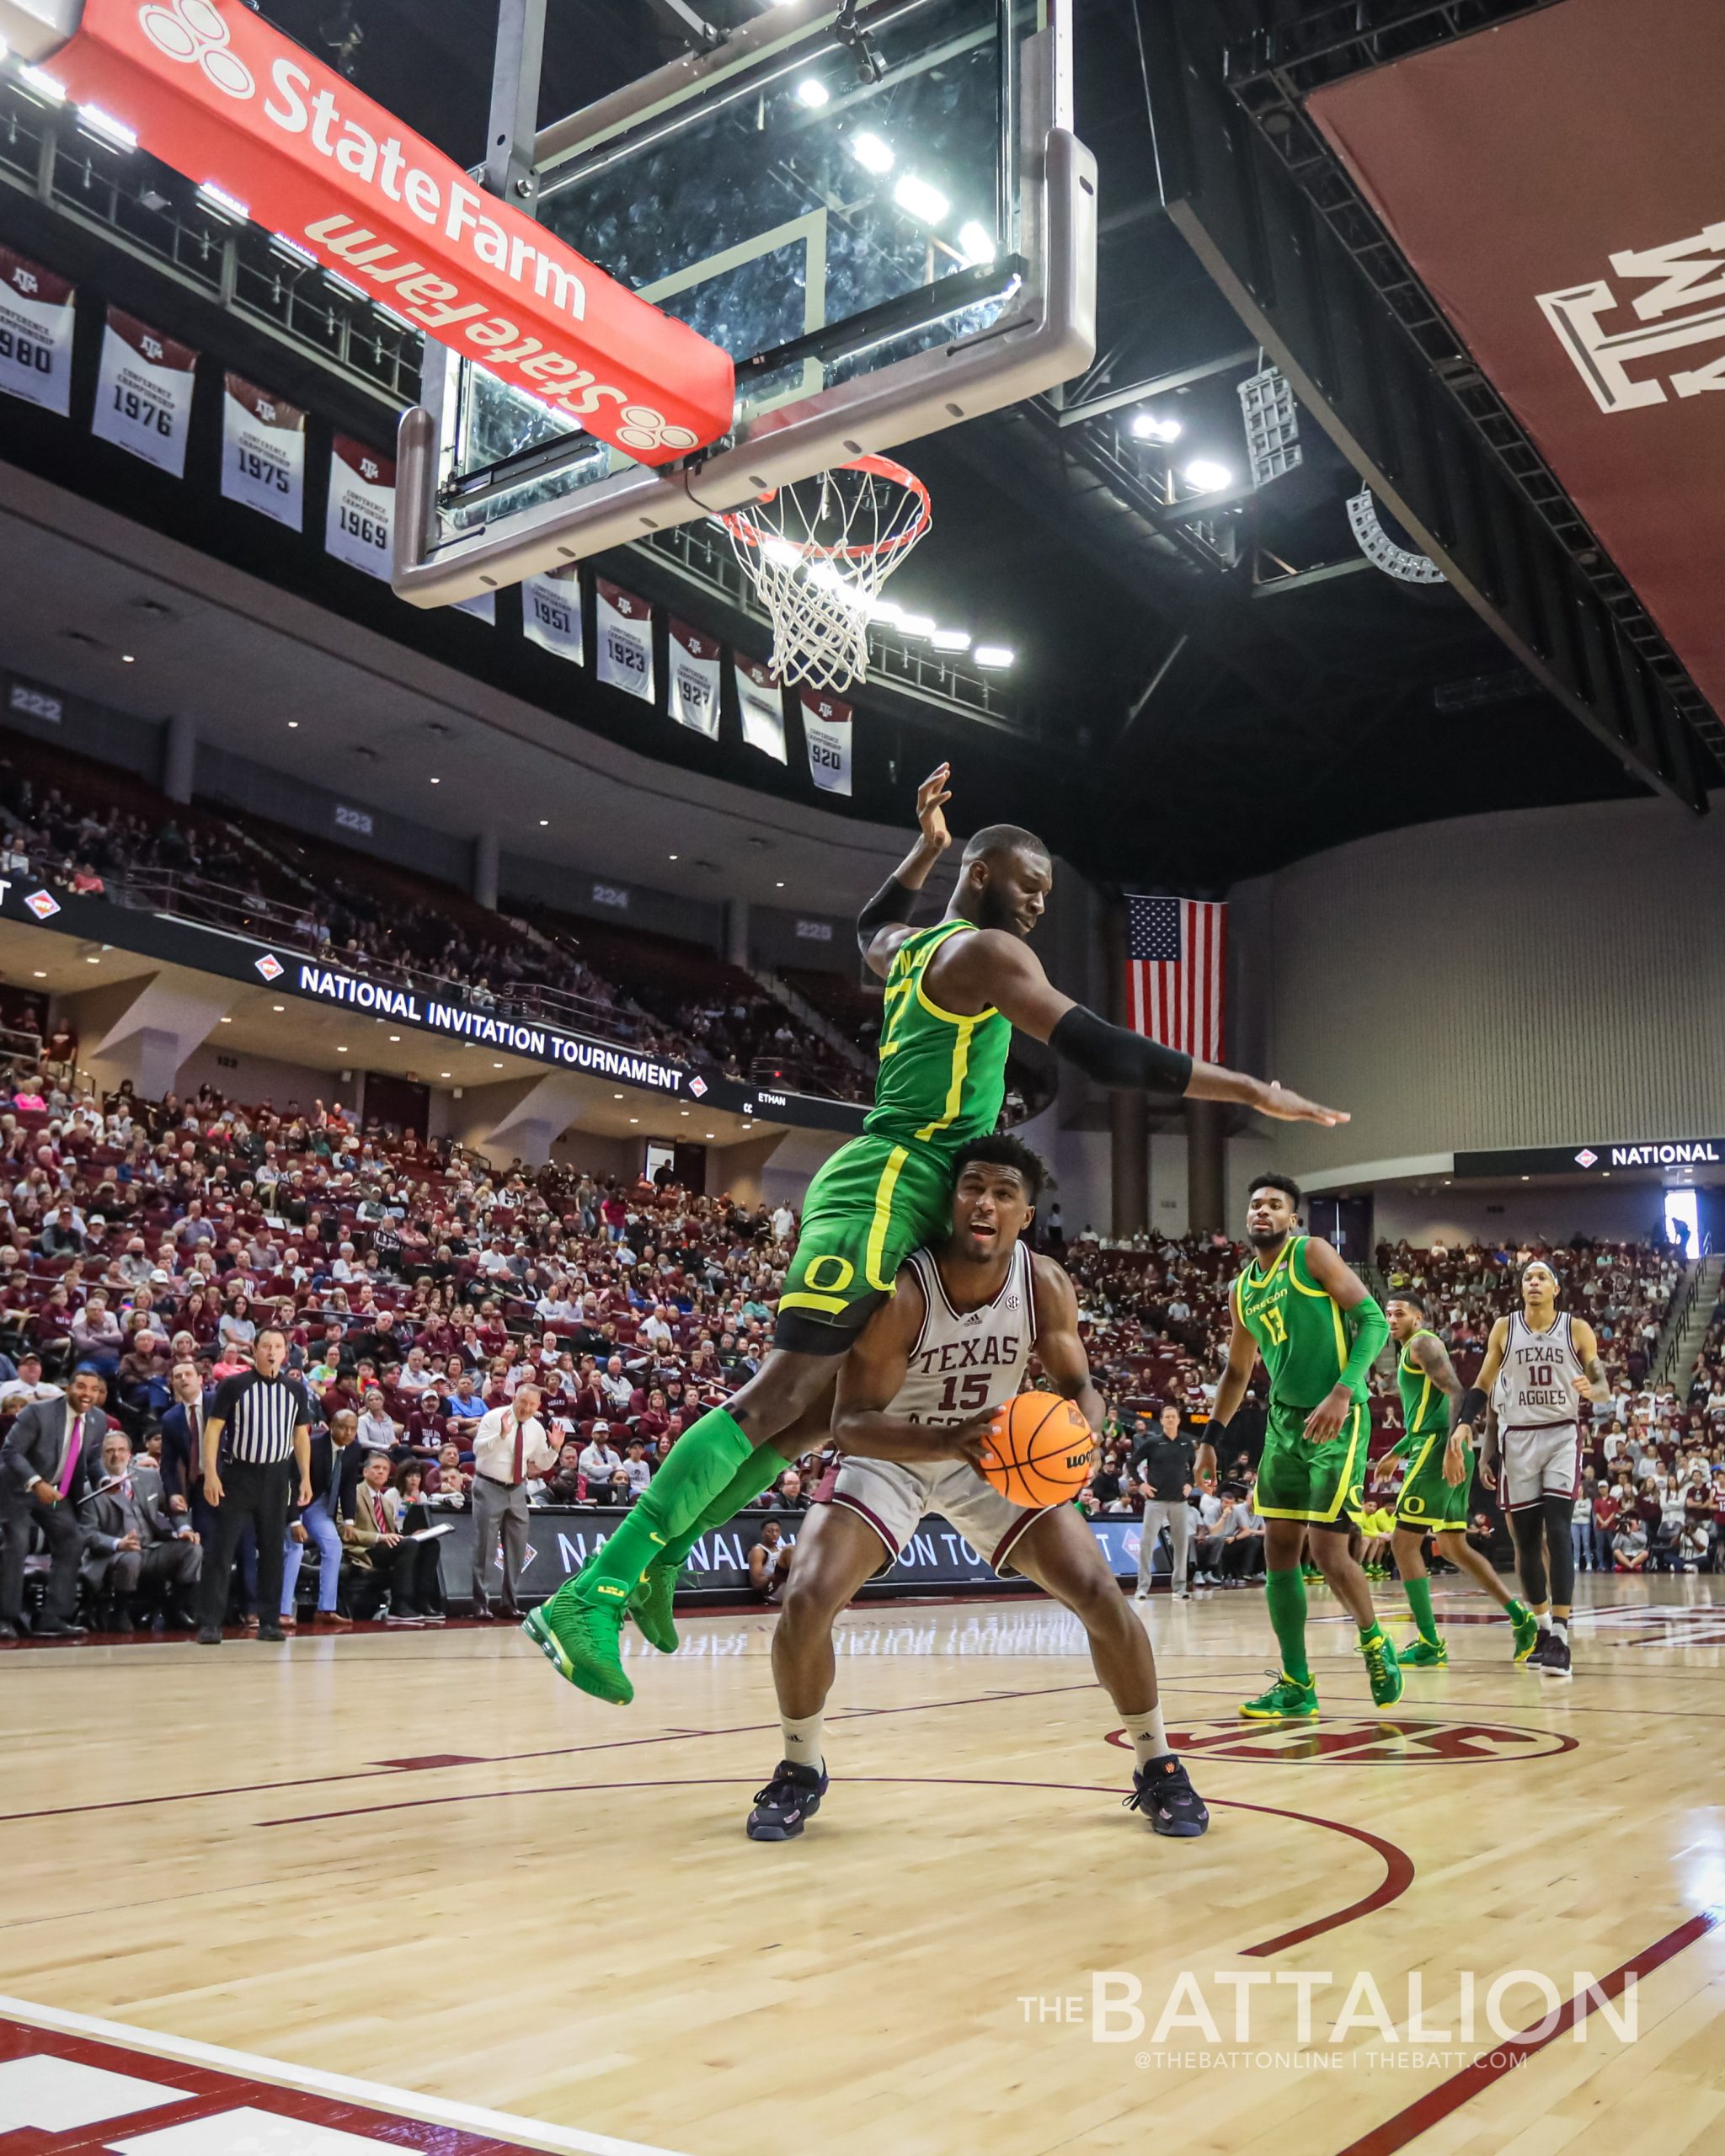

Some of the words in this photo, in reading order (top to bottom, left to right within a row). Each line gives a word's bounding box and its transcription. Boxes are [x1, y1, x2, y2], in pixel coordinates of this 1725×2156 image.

[0, 328, 51, 374] 980
[114, 385, 173, 437] 1976
[238, 448, 290, 494] 1975
[340, 506, 387, 550] 1969
[533, 598, 571, 633] 1951
[608, 638, 645, 673] 1923
[12, 687, 61, 724] 222
[812, 744, 841, 770] 920
[593, 885, 628, 909] 224
[301, 966, 421, 1021] NATIONAL
[429, 1002, 545, 1054] INVITATION
[552, 1038, 682, 1091] TOURNAMENT
[758, 1093, 786, 1107] ETHAN
[1612, 1144, 1719, 1166] NATIONAL
[1259, 1305, 1288, 1347] 13
[921, 1336, 1018, 1374] TEXAS
[1514, 1348, 1564, 1365] TEXAS
[937, 1373, 992, 1412] 15
[1528, 1365, 1552, 1387] 10
[1519, 1390, 1566, 1406] AGGIES
